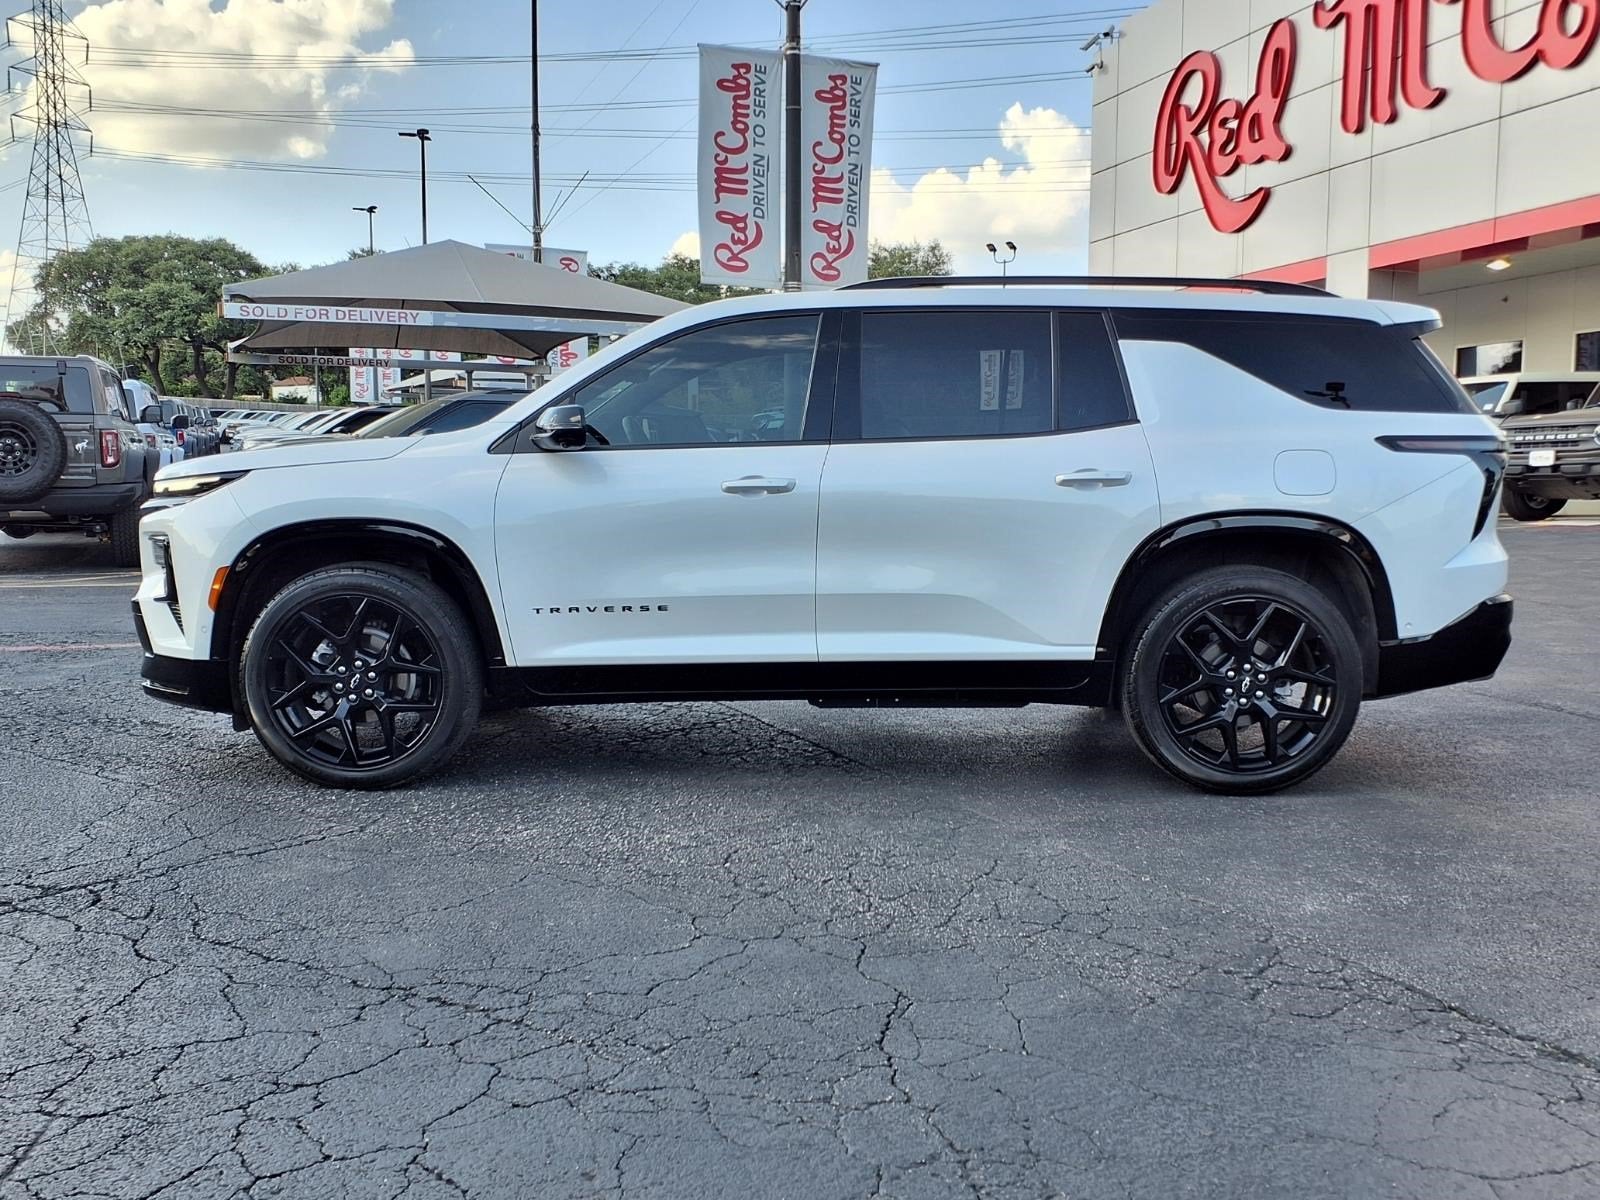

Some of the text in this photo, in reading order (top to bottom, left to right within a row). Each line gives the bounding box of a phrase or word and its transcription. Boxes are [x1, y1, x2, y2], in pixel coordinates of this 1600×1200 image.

[713, 61, 764, 273] Red McCombs
[752, 64, 767, 220] DRIVEN TO SERVE
[810, 73, 855, 282] Red McCombs
[846, 74, 863, 228] DRIVEN TO SERVE
[1153, 18, 1294, 234] Red
[239, 304, 420, 324] SOLD FOR DELIVERY
[278, 355, 390, 368] SOLD FOR DELIVERY
[532, 605, 669, 615] TRAVERSE
